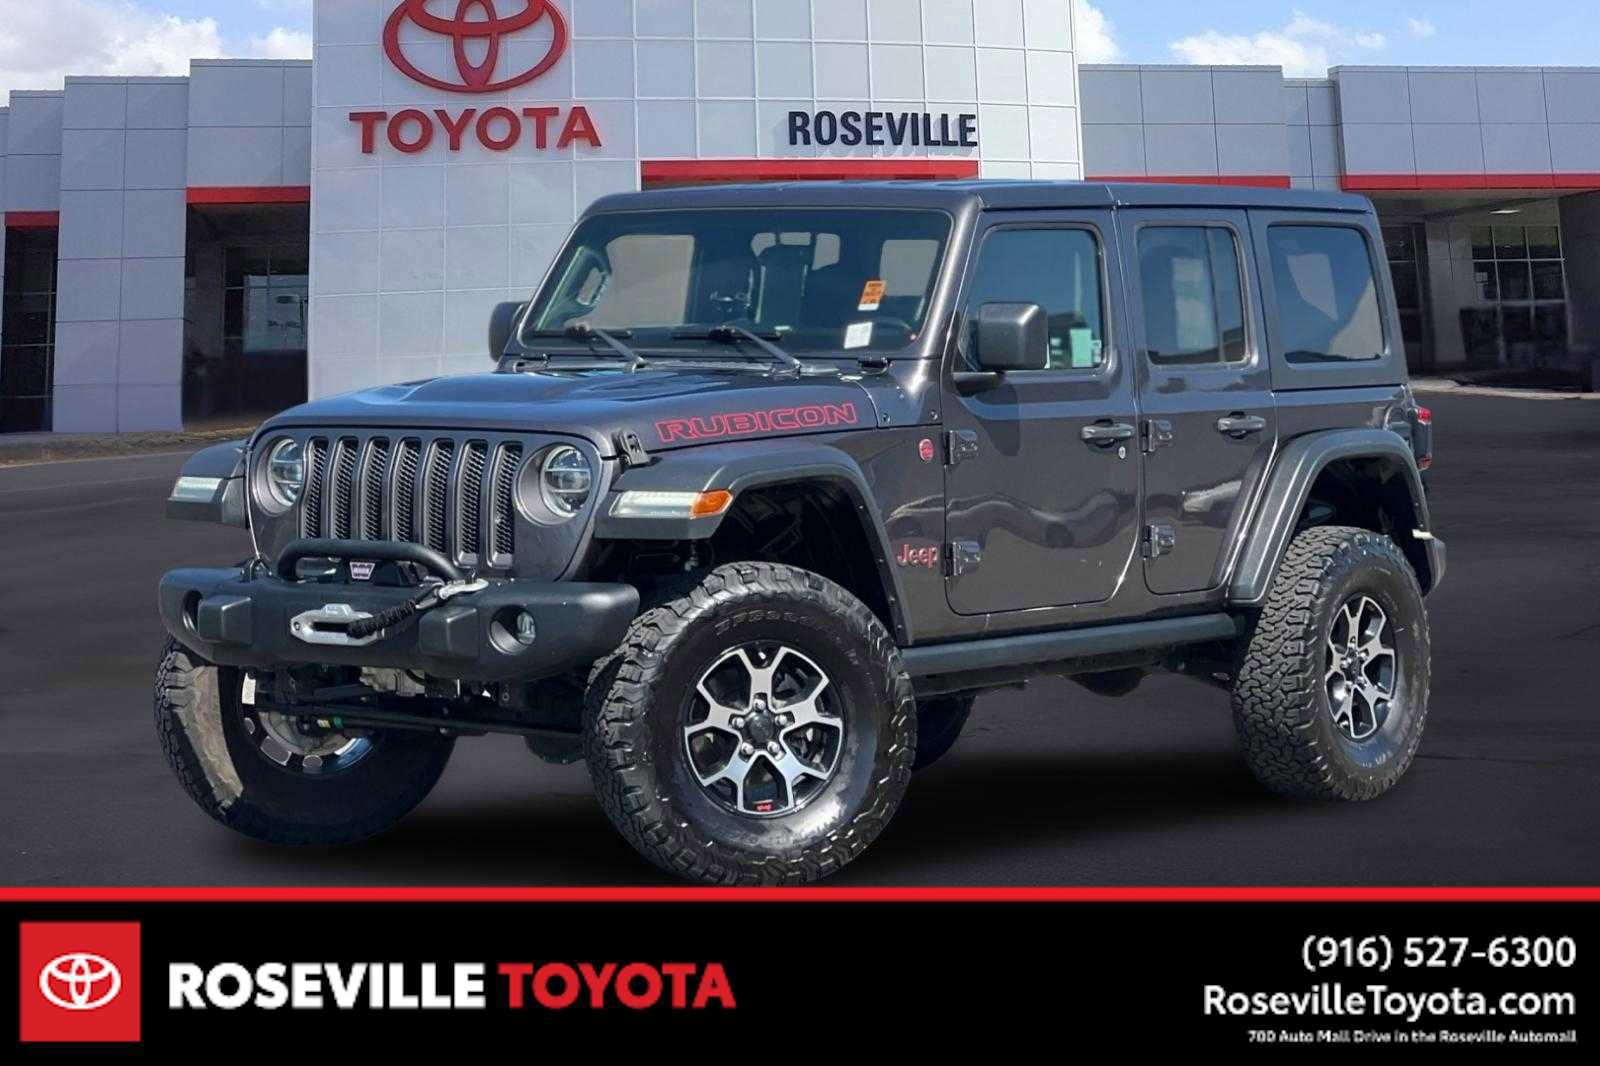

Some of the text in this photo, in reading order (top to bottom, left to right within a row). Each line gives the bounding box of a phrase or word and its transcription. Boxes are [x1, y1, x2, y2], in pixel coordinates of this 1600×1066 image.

[349, 106, 602, 154] TOYOTA
[788, 111, 978, 147] ROSEVILLE
[655, 403, 857, 443] RUBICON
[897, 544, 939, 568] Jeep
